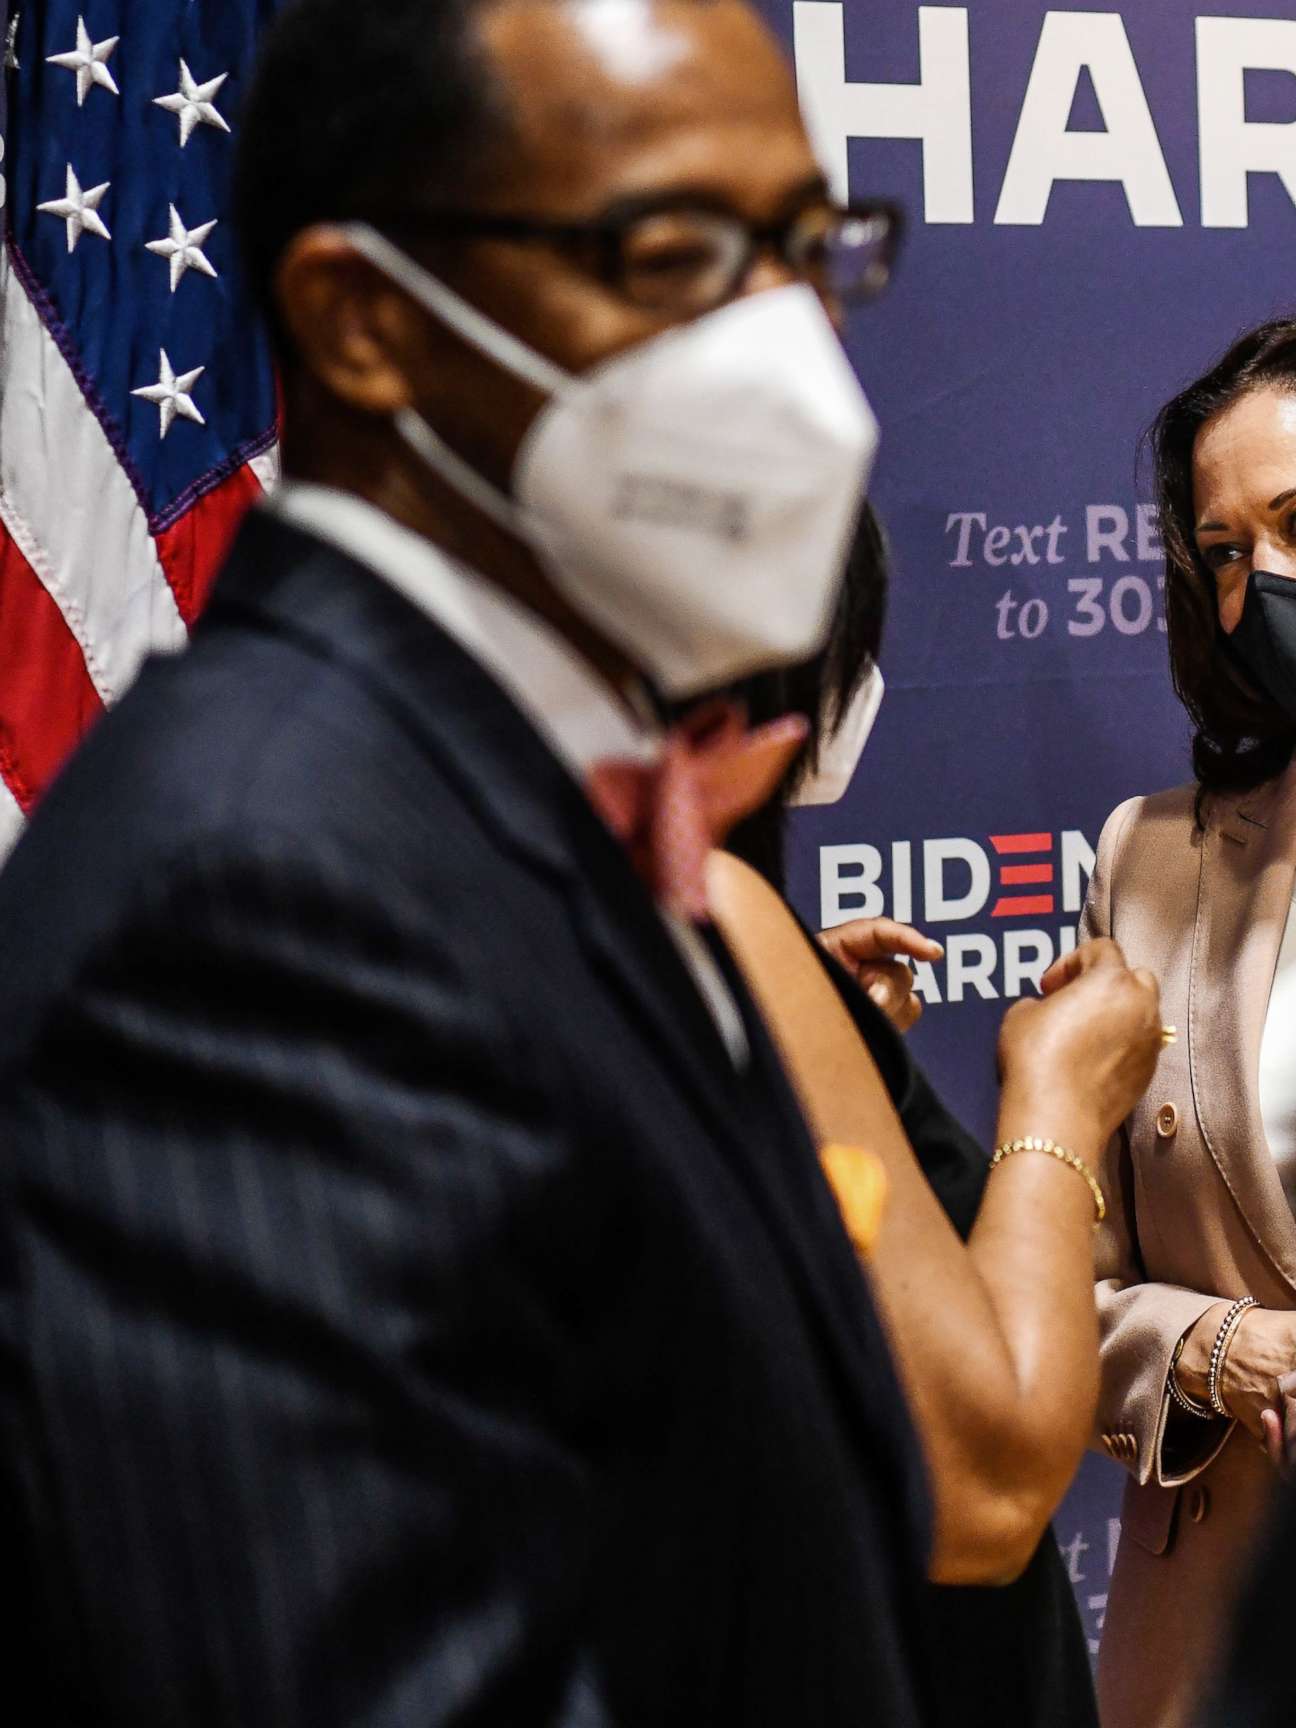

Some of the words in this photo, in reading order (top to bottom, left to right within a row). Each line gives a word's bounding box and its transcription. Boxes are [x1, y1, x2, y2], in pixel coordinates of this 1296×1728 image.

[945, 512, 1068, 567] Text
[995, 588, 1049, 639] to
[1067, 575, 1168, 636] 30
[819, 830, 1097, 929] BIDEN
[893, 926, 1076, 1004] ARR
